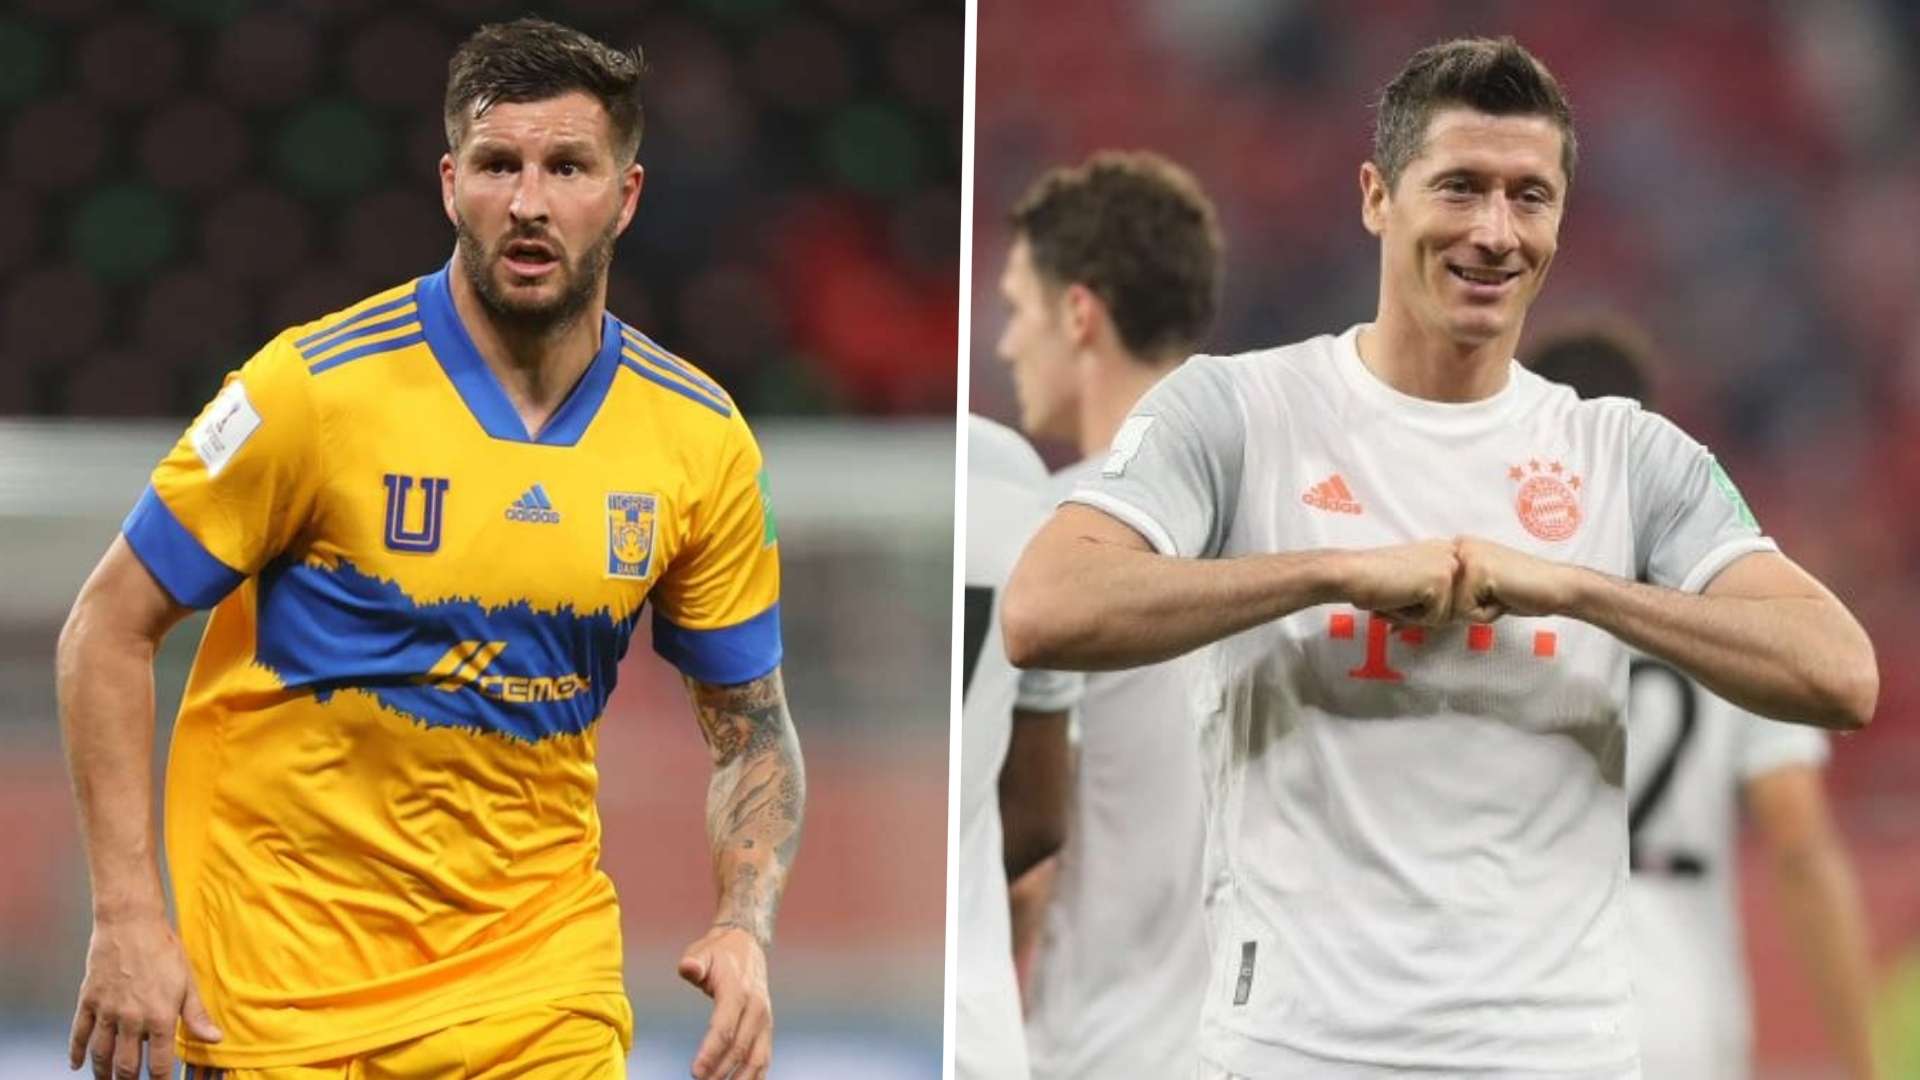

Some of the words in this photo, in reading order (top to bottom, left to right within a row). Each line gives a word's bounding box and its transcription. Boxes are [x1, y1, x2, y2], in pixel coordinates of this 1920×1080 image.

[384, 474, 449, 553] U
[1302, 493, 1362, 515] adidas
[504, 508, 560, 524] adidas
